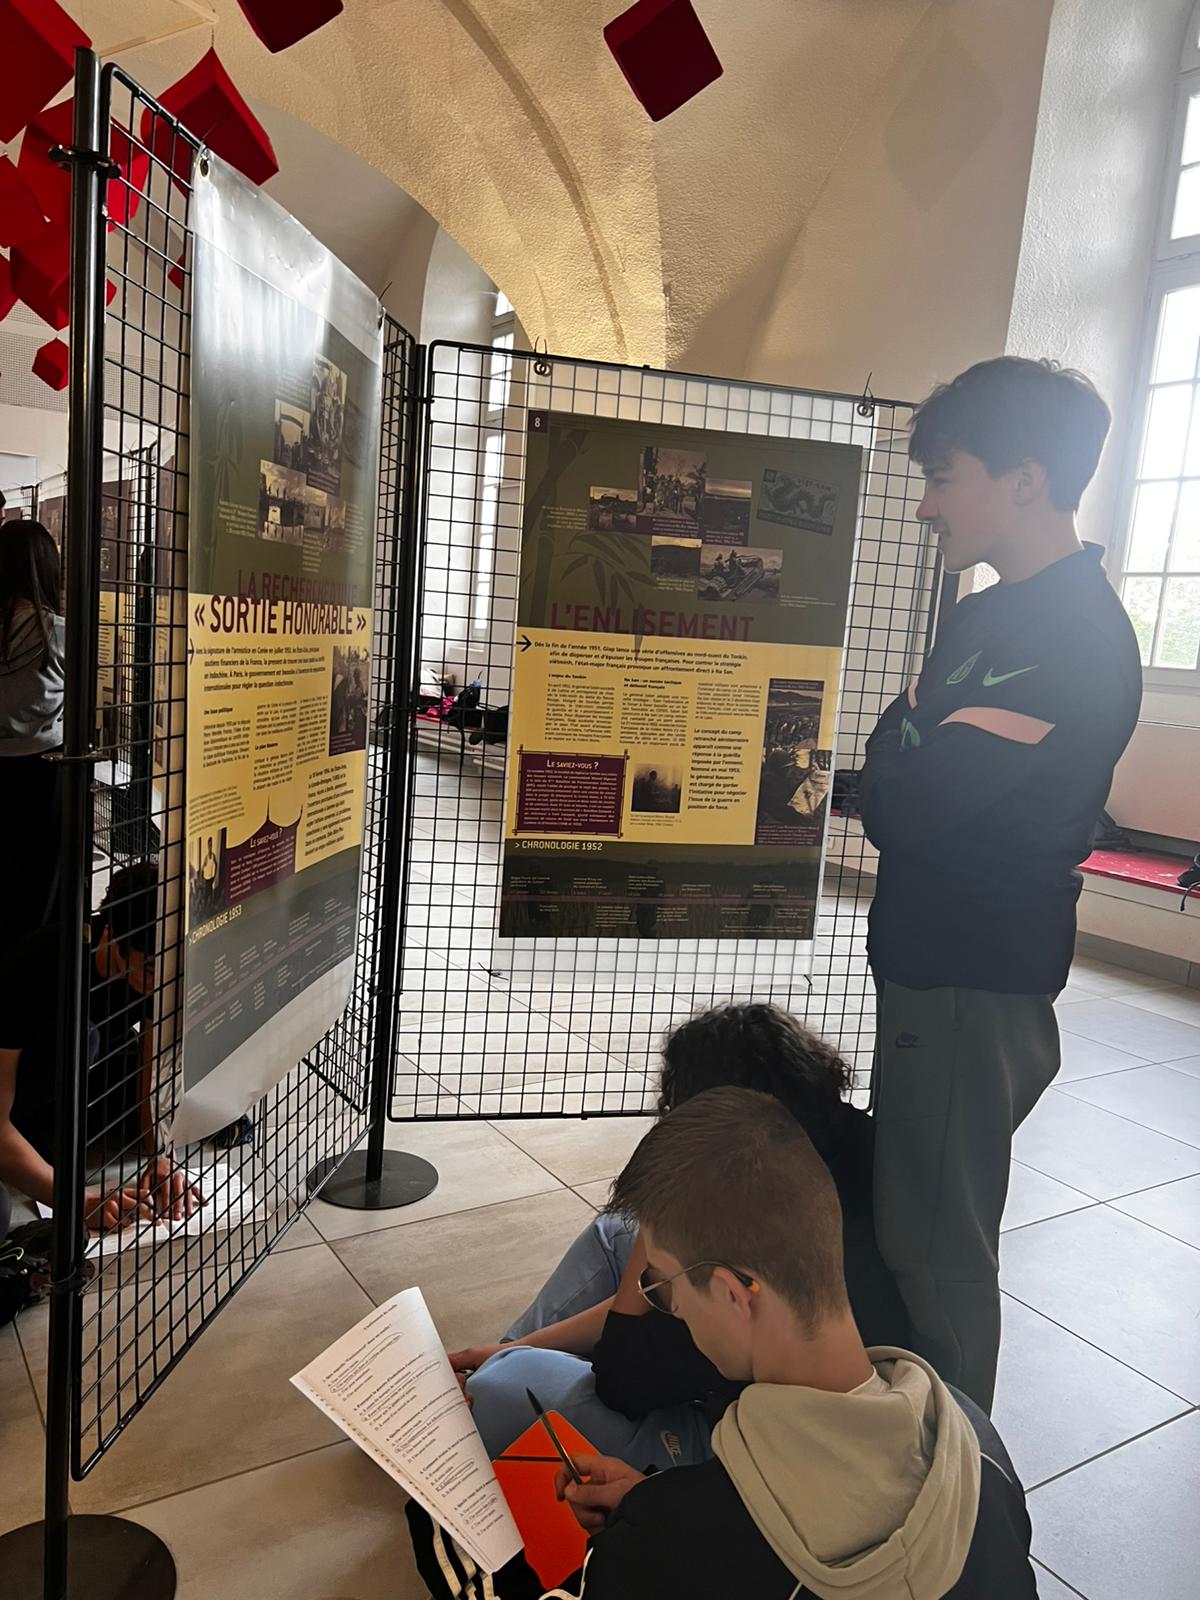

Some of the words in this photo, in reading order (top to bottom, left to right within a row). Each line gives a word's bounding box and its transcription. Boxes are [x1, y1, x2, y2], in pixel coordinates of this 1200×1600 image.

[535, 417, 540, 428] 8
[210, 595, 277, 634] SORTIE
[283, 601, 352, 634] HONORABLE
[552, 602, 754, 641] L'ENLISEMENT
[522, 841, 579, 849] CHRONOLOGIE
[192, 914, 228, 944] CHRONOLOGIE
[229, 904, 242, 921] 1953
